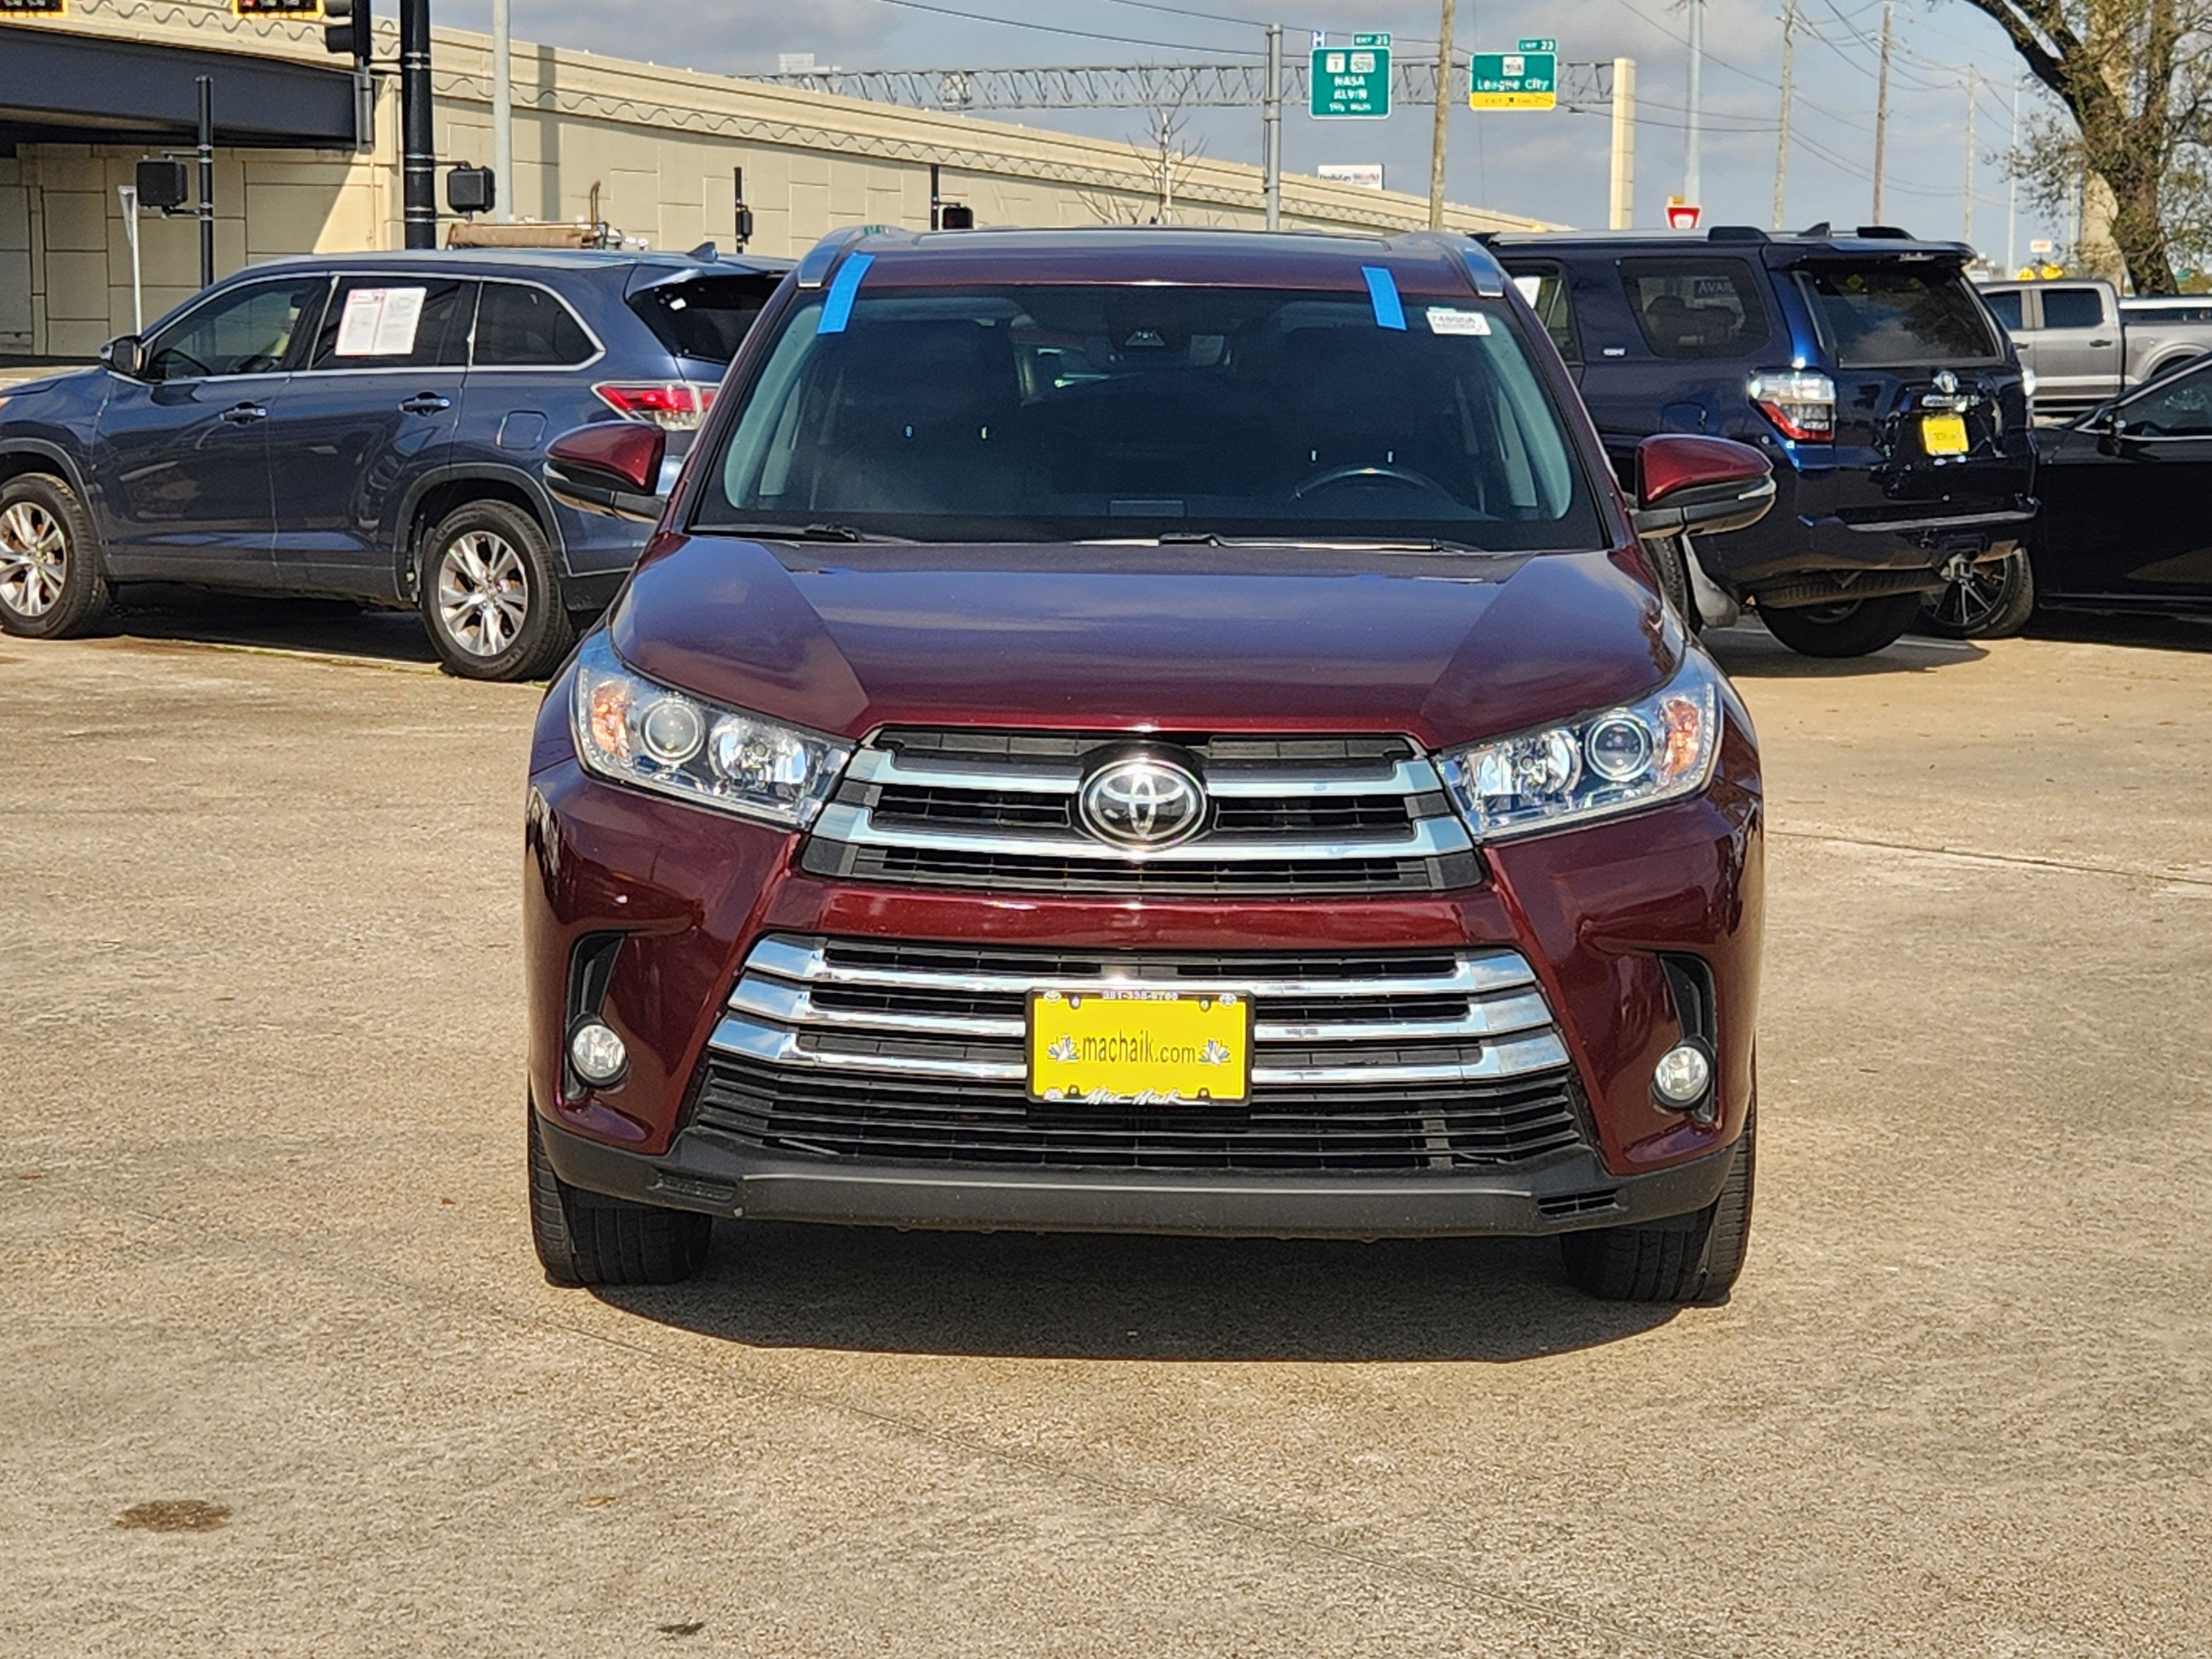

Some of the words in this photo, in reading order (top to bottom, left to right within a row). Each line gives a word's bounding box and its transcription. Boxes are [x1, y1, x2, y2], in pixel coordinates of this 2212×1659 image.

[1334, 75, 1365, 87] NASA
[1477, 77, 1520, 91] League
[1525, 77, 1550, 91] City
[1333, 88, 1368, 101] ALVIN
[1082, 1029, 1196, 1063] machaik.com
[1132, 1087, 1180, 1105] Haik
